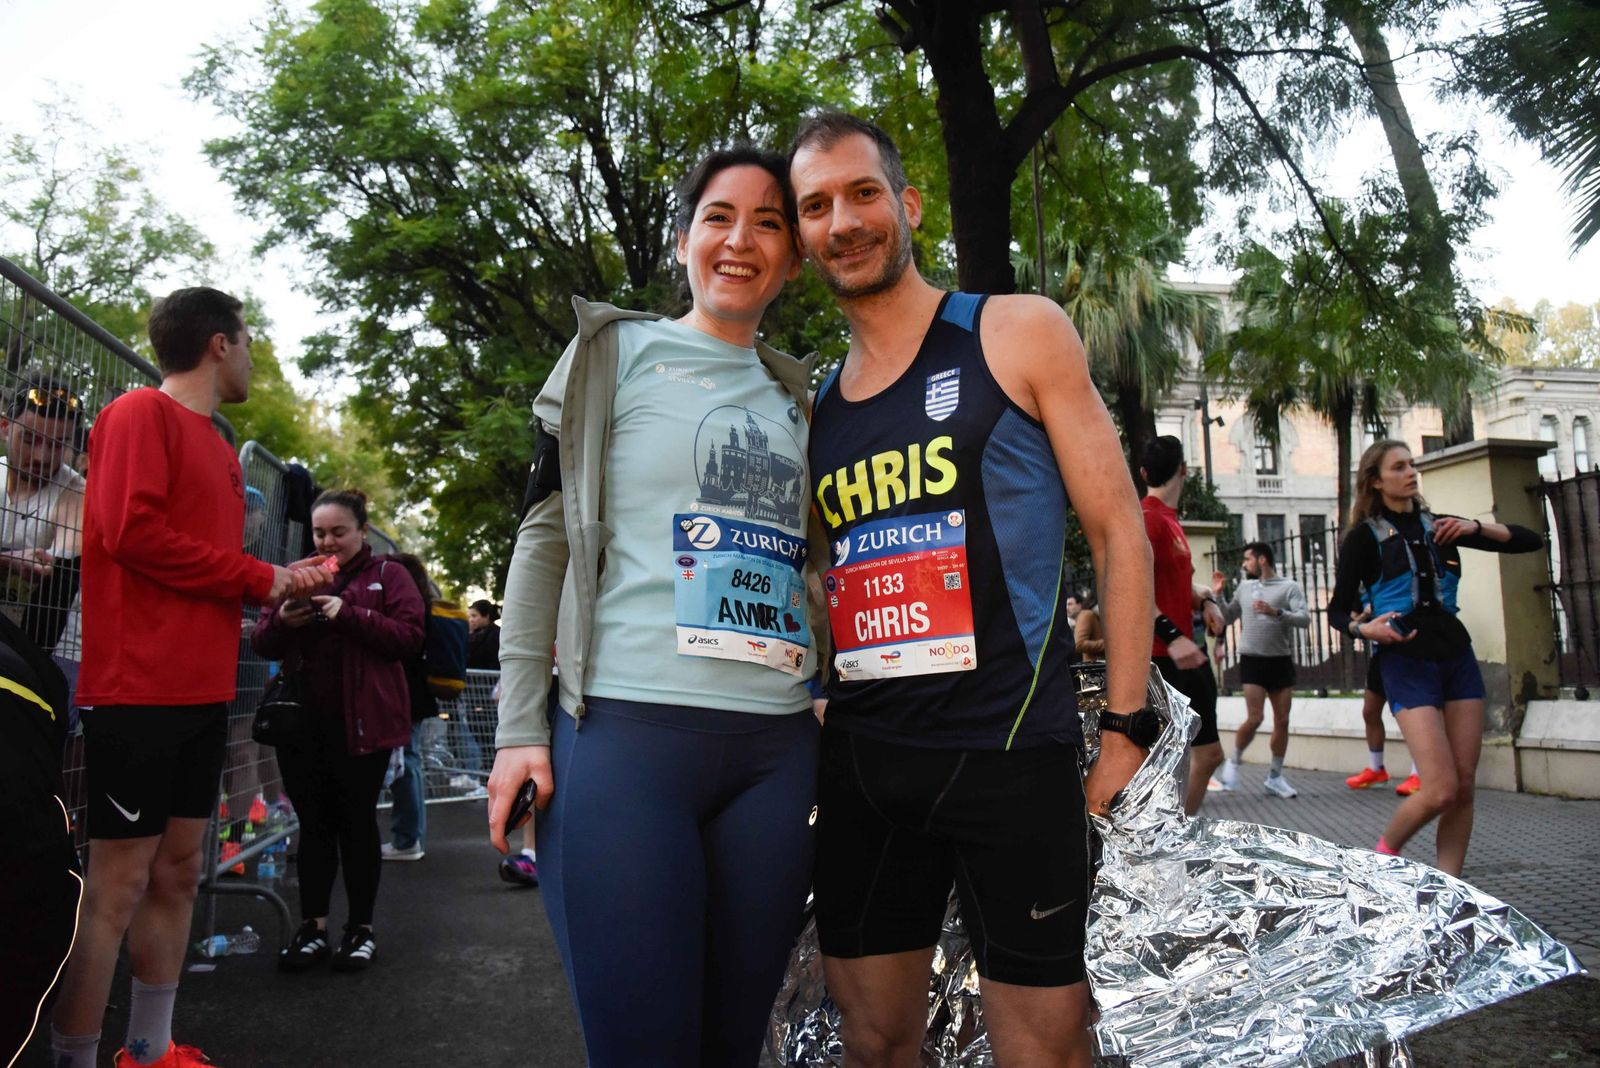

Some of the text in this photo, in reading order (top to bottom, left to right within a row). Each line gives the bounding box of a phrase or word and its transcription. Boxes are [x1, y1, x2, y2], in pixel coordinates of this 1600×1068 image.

[931, 369, 956, 381] GREECE
[817, 436, 957, 528] CHRIS
[730, 528, 799, 560] ZURICH
[857, 522, 942, 553] ZURICH
[888, 556, 907, 565] SEVILLA
[731, 568, 771, 594] 8426
[864, 573, 905, 598] 1133
[855, 601, 931, 642] CHRIS
[698, 637, 719, 645] asics
